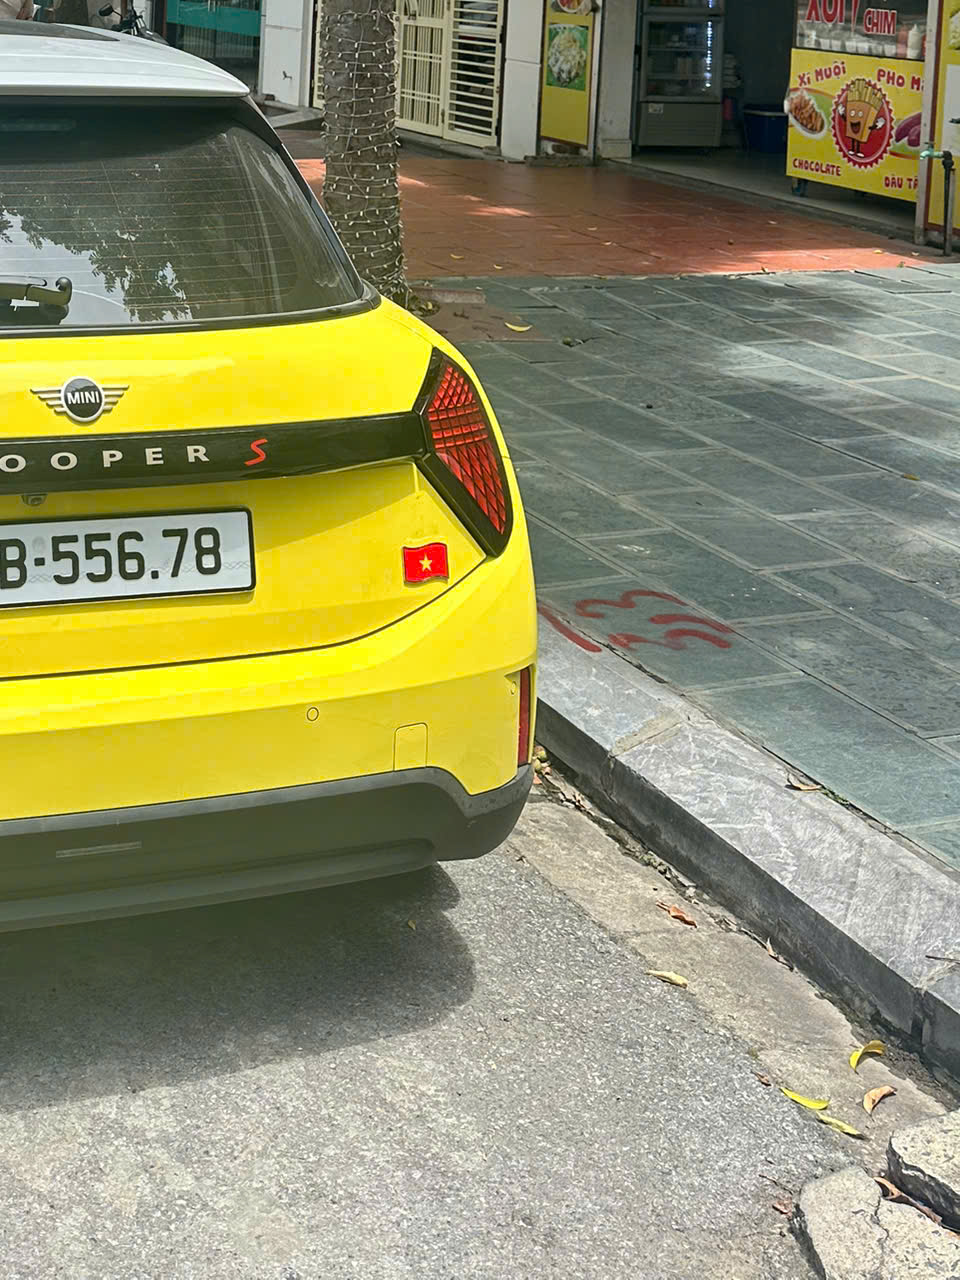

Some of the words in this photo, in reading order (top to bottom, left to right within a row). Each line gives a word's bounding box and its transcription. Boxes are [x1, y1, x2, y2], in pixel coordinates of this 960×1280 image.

[863, 8, 897, 35] CHIM
[877, 68, 905, 88] PHO
[792, 157, 842, 177] CHOCOLATE
[66, 390, 100, 406] MINI
[244, 438, 268, 466] S
